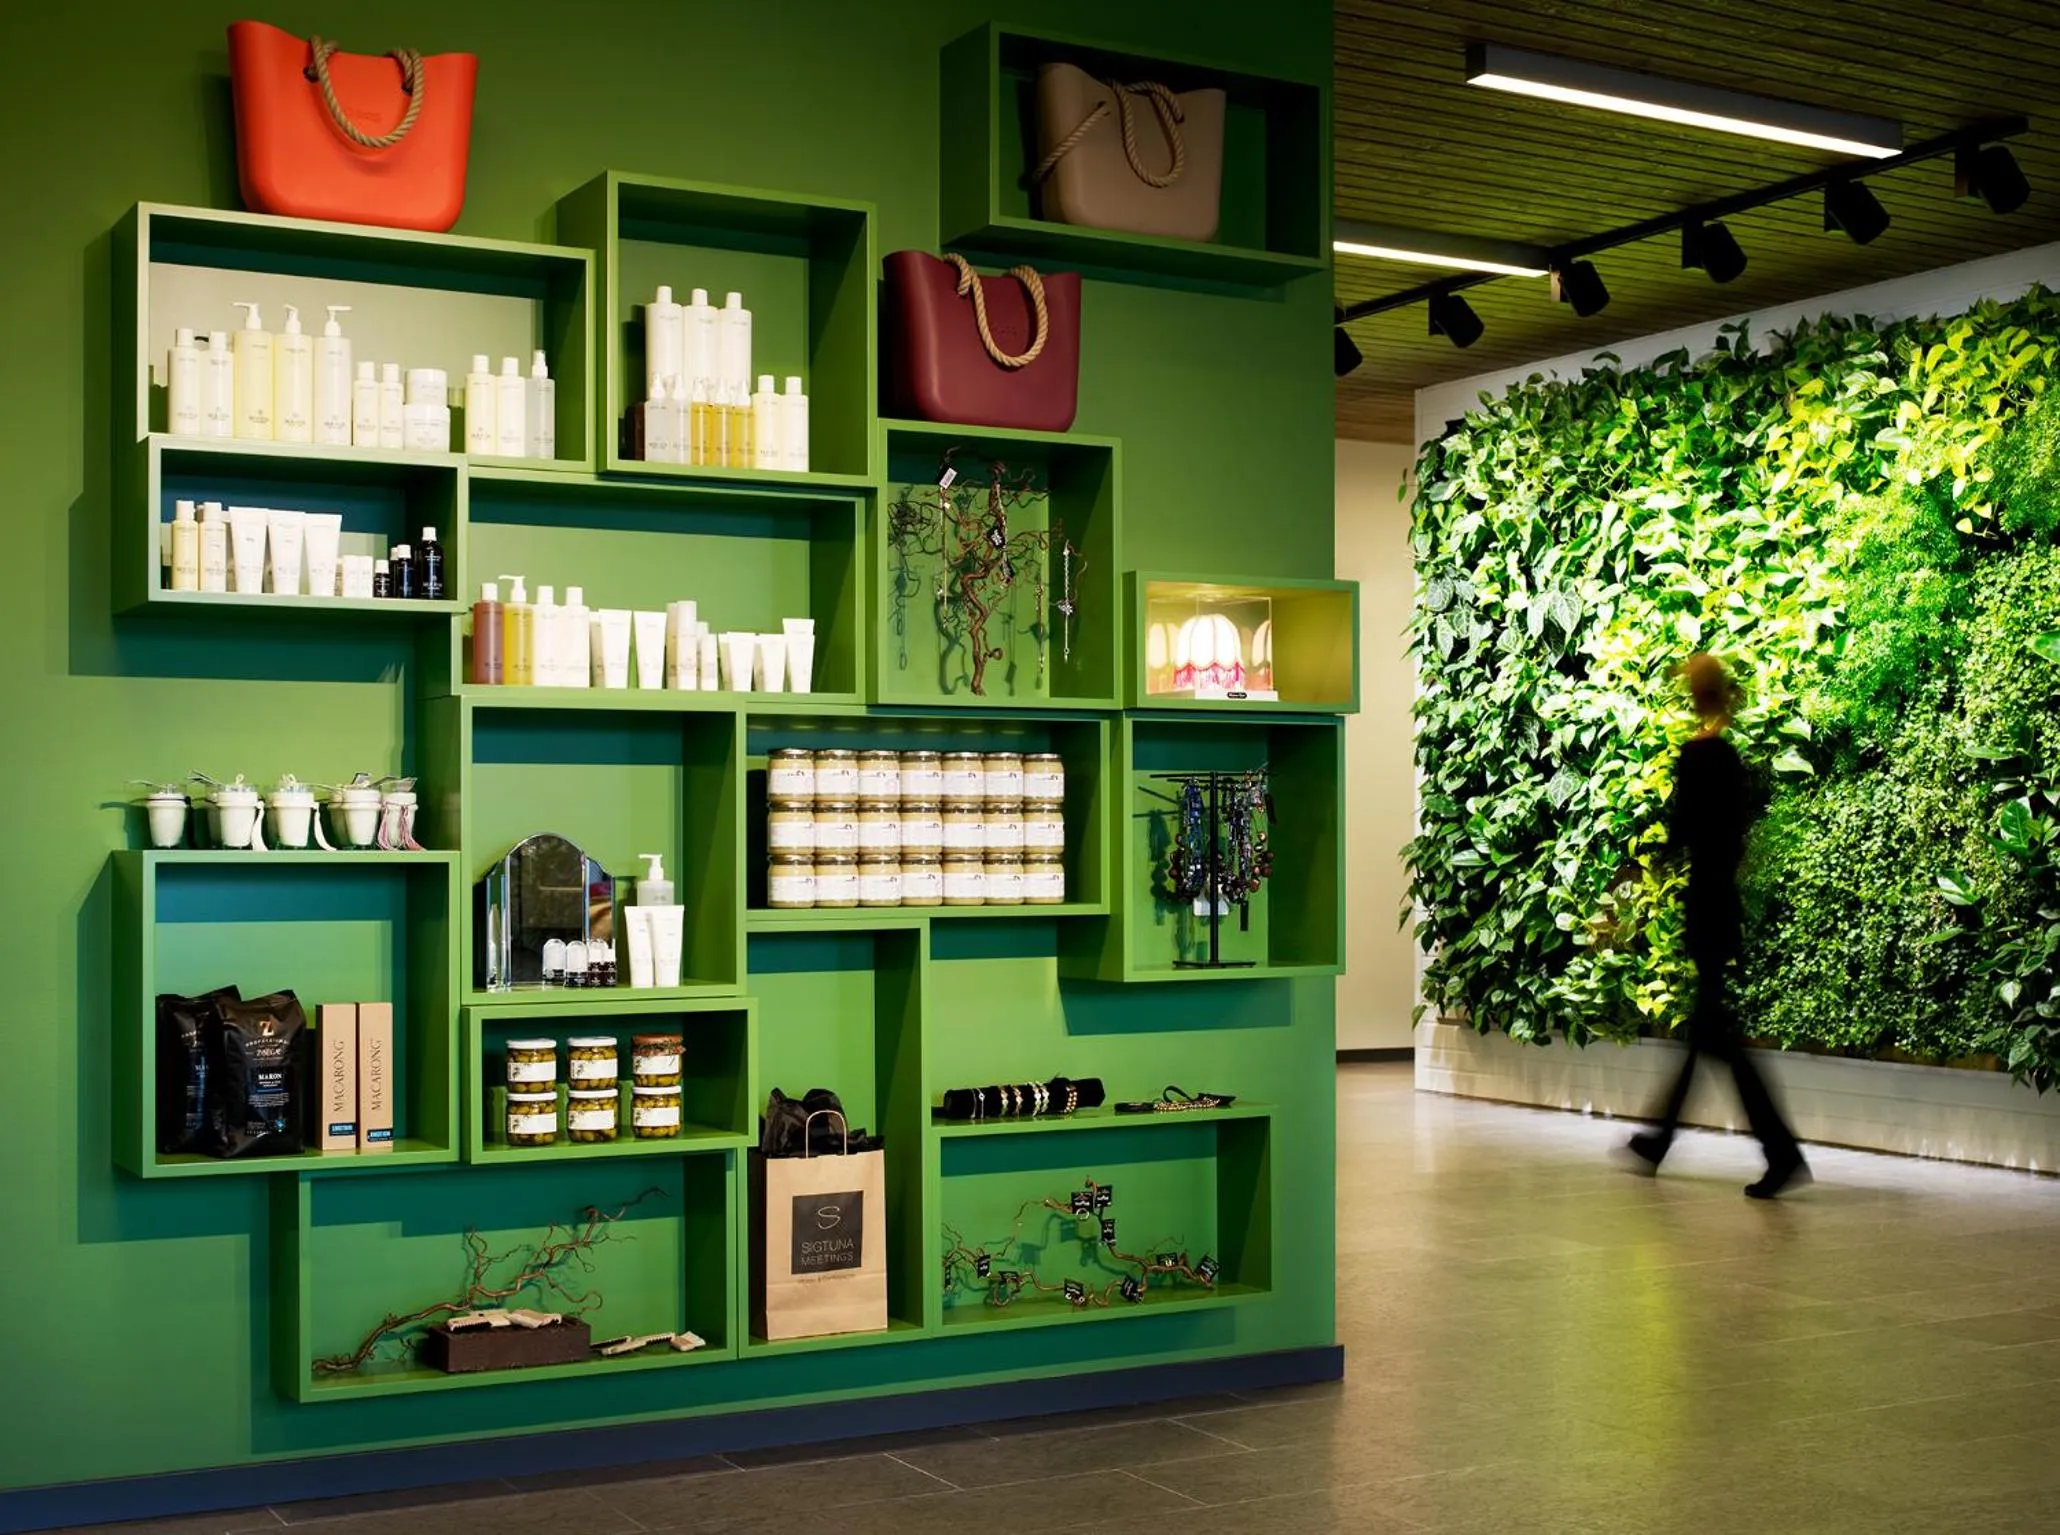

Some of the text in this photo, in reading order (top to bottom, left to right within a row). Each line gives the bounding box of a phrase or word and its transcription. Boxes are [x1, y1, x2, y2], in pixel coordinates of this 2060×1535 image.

[259, 1020, 275, 1036] Z
[333, 1040, 344, 1112] MACARONG
[371, 1038, 382, 1111] MACARONG
[817, 1206, 840, 1229] S
[801, 1238, 854, 1253] SIGTUNA
[801, 1252, 854, 1266] MEETINGS
